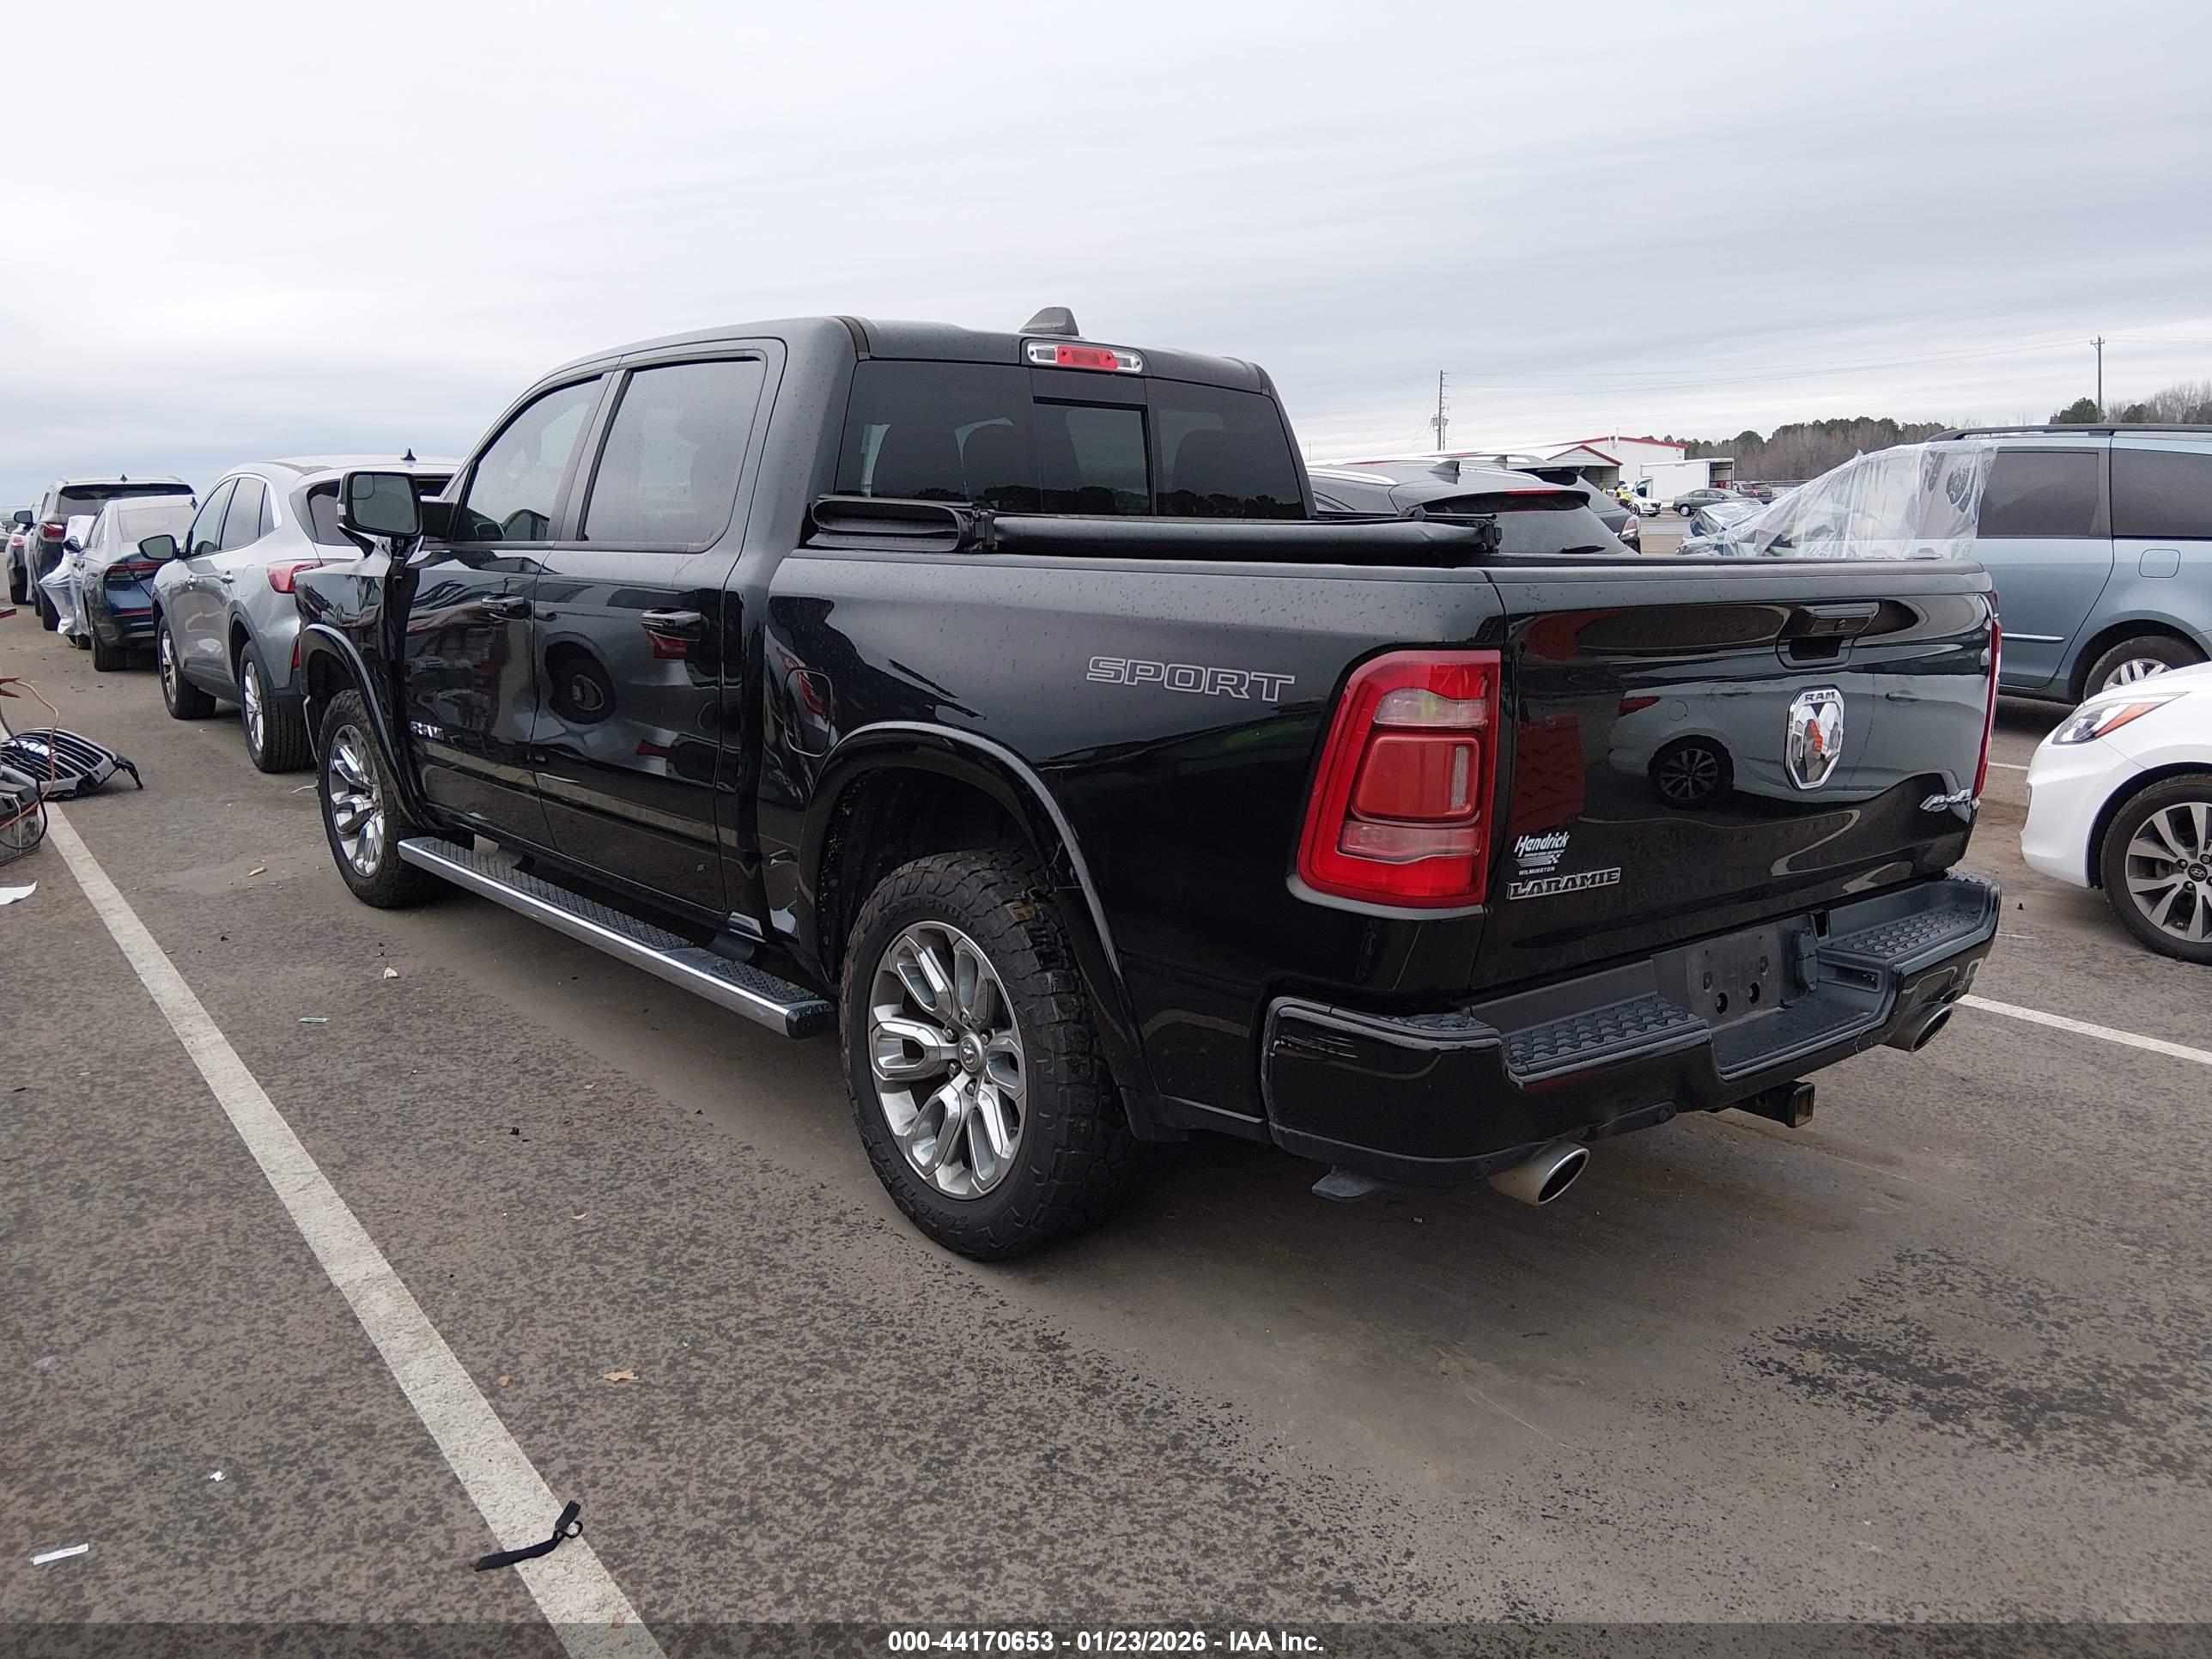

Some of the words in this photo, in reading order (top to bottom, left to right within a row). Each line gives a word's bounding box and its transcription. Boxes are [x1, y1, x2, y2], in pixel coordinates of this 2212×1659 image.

[1086, 656, 1296, 702] SPORT
[1804, 691, 1836, 702] RAM
[1514, 831, 1570, 857] Hendrick
[1506, 867, 1621, 900] LARAMIE
[1518, 866, 1555, 876] WILMINGTON
